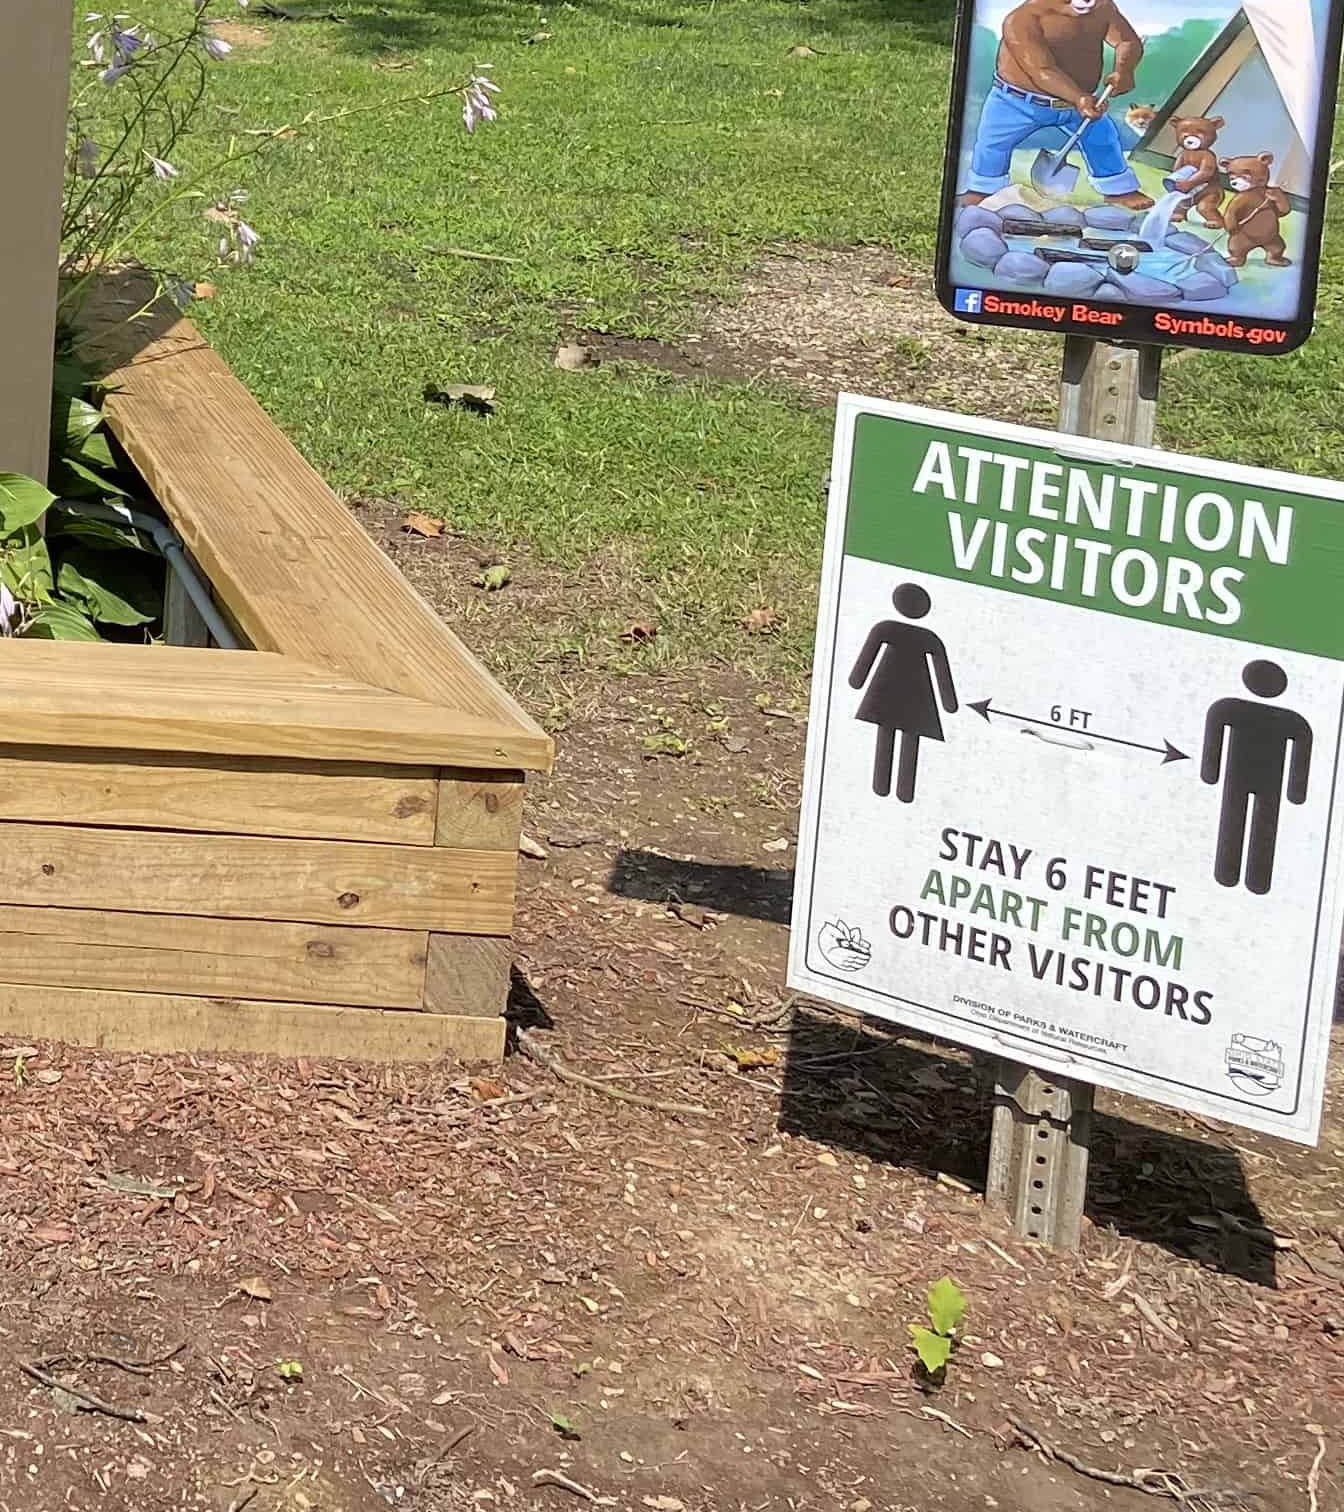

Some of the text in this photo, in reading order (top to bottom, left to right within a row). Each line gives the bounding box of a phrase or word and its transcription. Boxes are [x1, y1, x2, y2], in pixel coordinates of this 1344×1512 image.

[985, 296, 1068, 321] Smokey
[1072, 305, 1121, 325] Bear
[1154, 312, 1287, 344] Symbols.gov
[912, 440, 1294, 566] ATTENTION
[949, 512, 1243, 626] VISITORS
[1050, 704, 1093, 729] 6 FT
[920, 870, 1184, 971] APART FROM
[939, 827, 1176, 919] STAY 6 FEET
[888, 907, 1213, 1026] OTHER VISITORS
[953, 994, 995, 1014] DIVISION
[997, 1008, 1011, 1017] OF
[1014, 1013, 1046, 1030] PARKS
